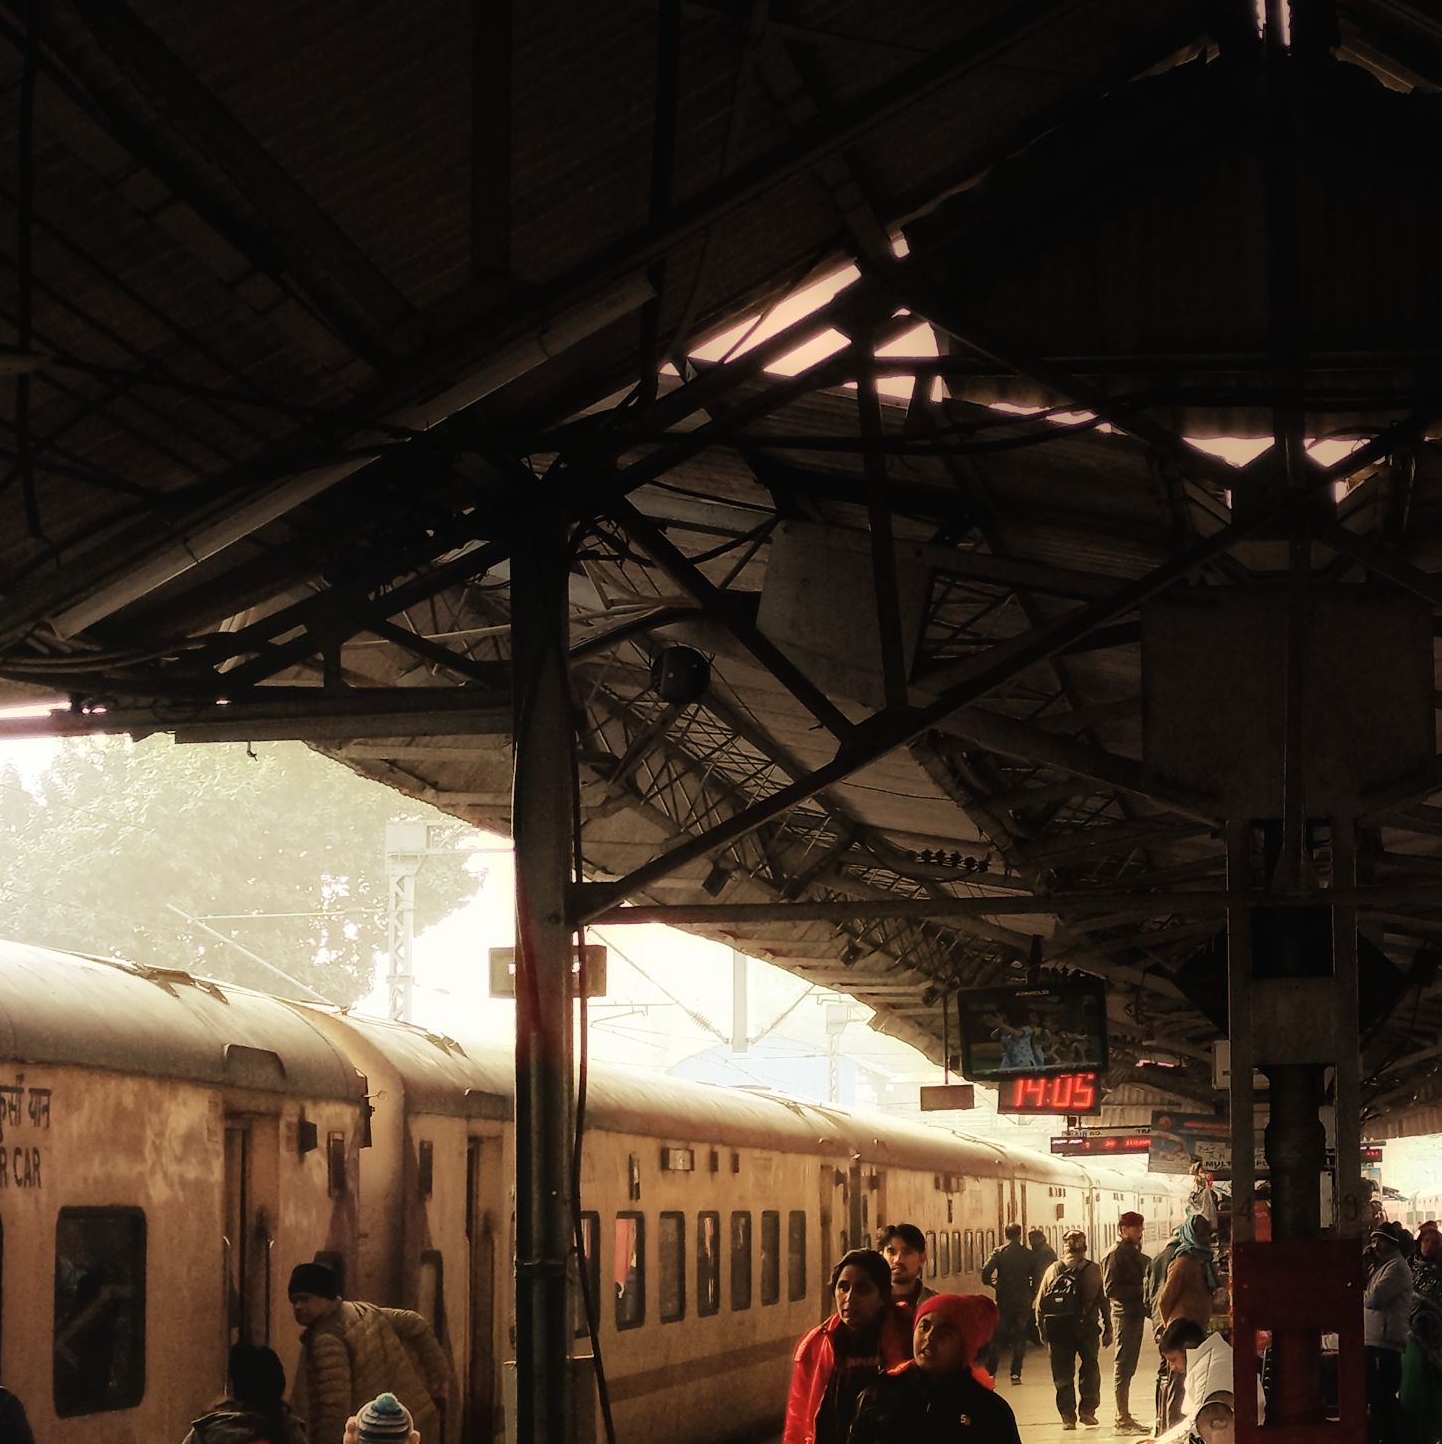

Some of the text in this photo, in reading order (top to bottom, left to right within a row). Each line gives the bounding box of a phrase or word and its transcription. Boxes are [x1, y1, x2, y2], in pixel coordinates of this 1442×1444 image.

[28, 1088, 52, 1129] यान
[1014, 1073, 1096, 1109] 14:05
[13, 1146, 42, 1189] CAR
